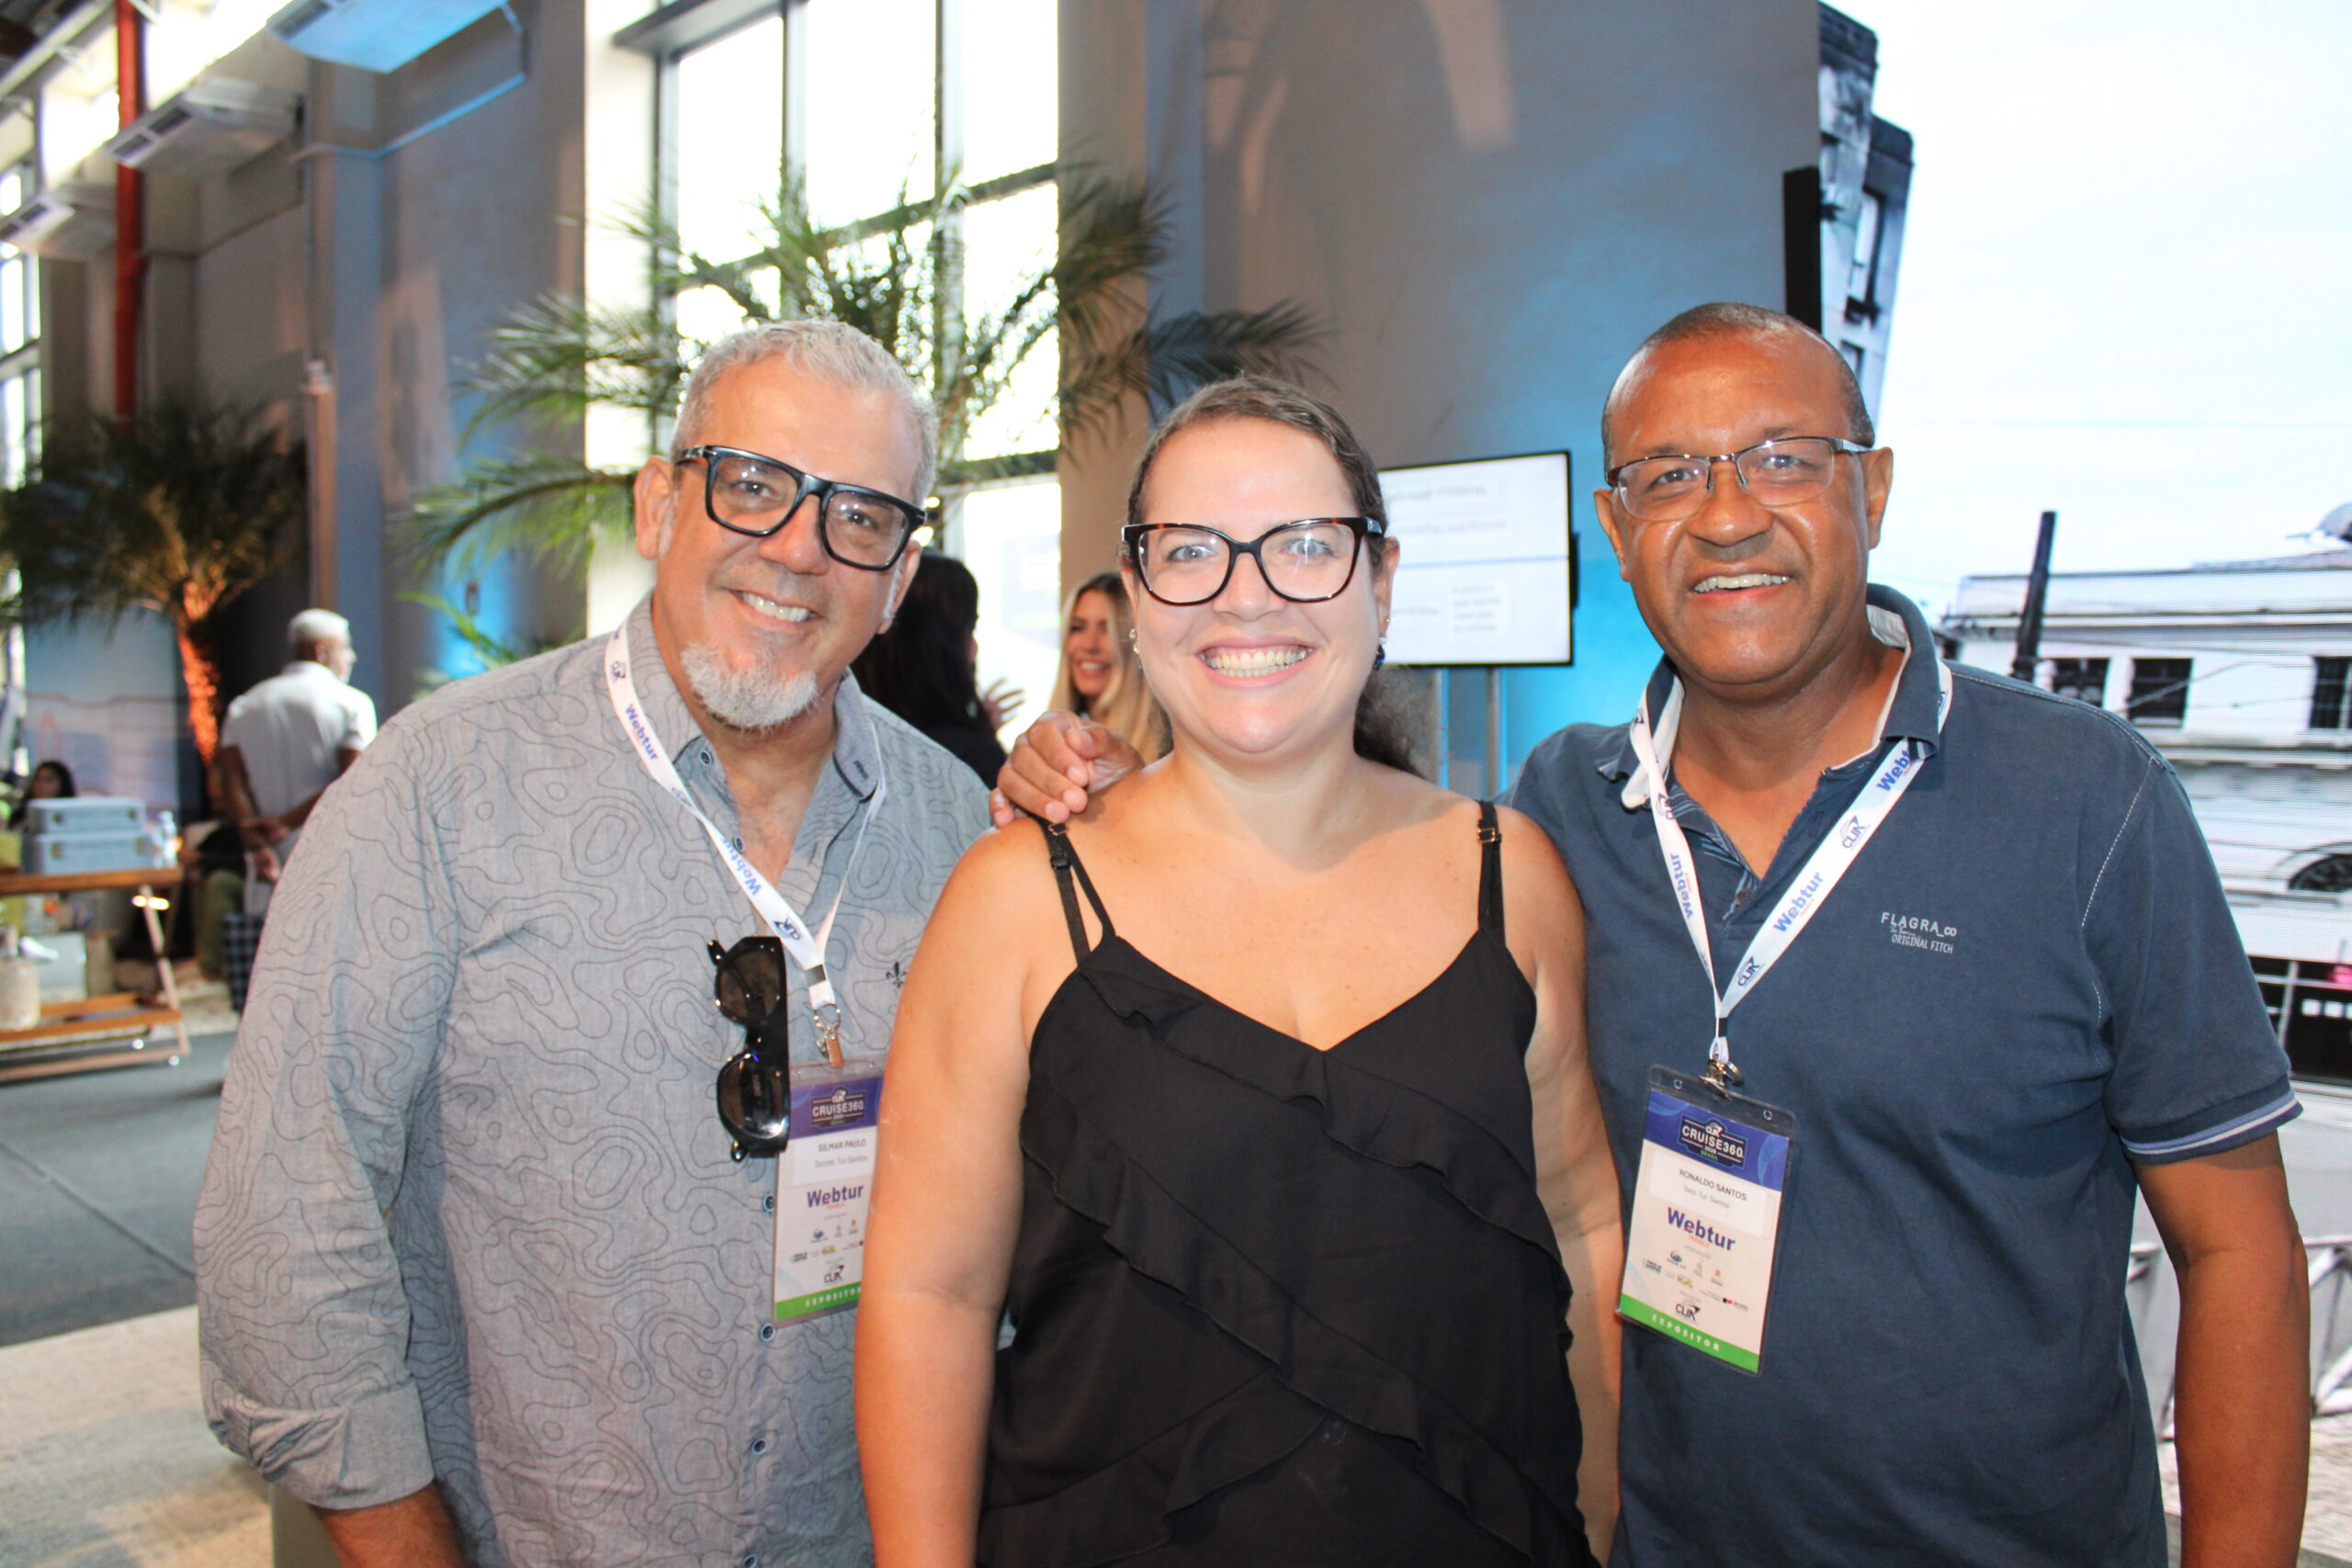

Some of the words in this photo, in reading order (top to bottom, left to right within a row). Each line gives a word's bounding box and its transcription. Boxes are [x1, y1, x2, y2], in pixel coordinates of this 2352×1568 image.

[625, 704, 659, 761] Webtur
[1876, 750, 1910, 791] Webt
[720, 837, 763, 896] Webtur
[1670, 853, 1694, 919] Webtur
[1772, 872, 1823, 931] Webtur
[1891, 933, 1928, 950] ORIGINAL
[1930, 940, 1954, 954] FITCH
[812, 1100, 865, 1117] CRUISE360
[1681, 1124, 1745, 1158] CRUISE360
[807, 1185, 864, 1208] Webtur
[1679, 1168, 1714, 1189] RONALDO
[1715, 1183, 1747, 1201] SANTOS
[1668, 1206, 1736, 1251] Webtur
[1652, 1314, 1720, 1351] EXPOSITOR
